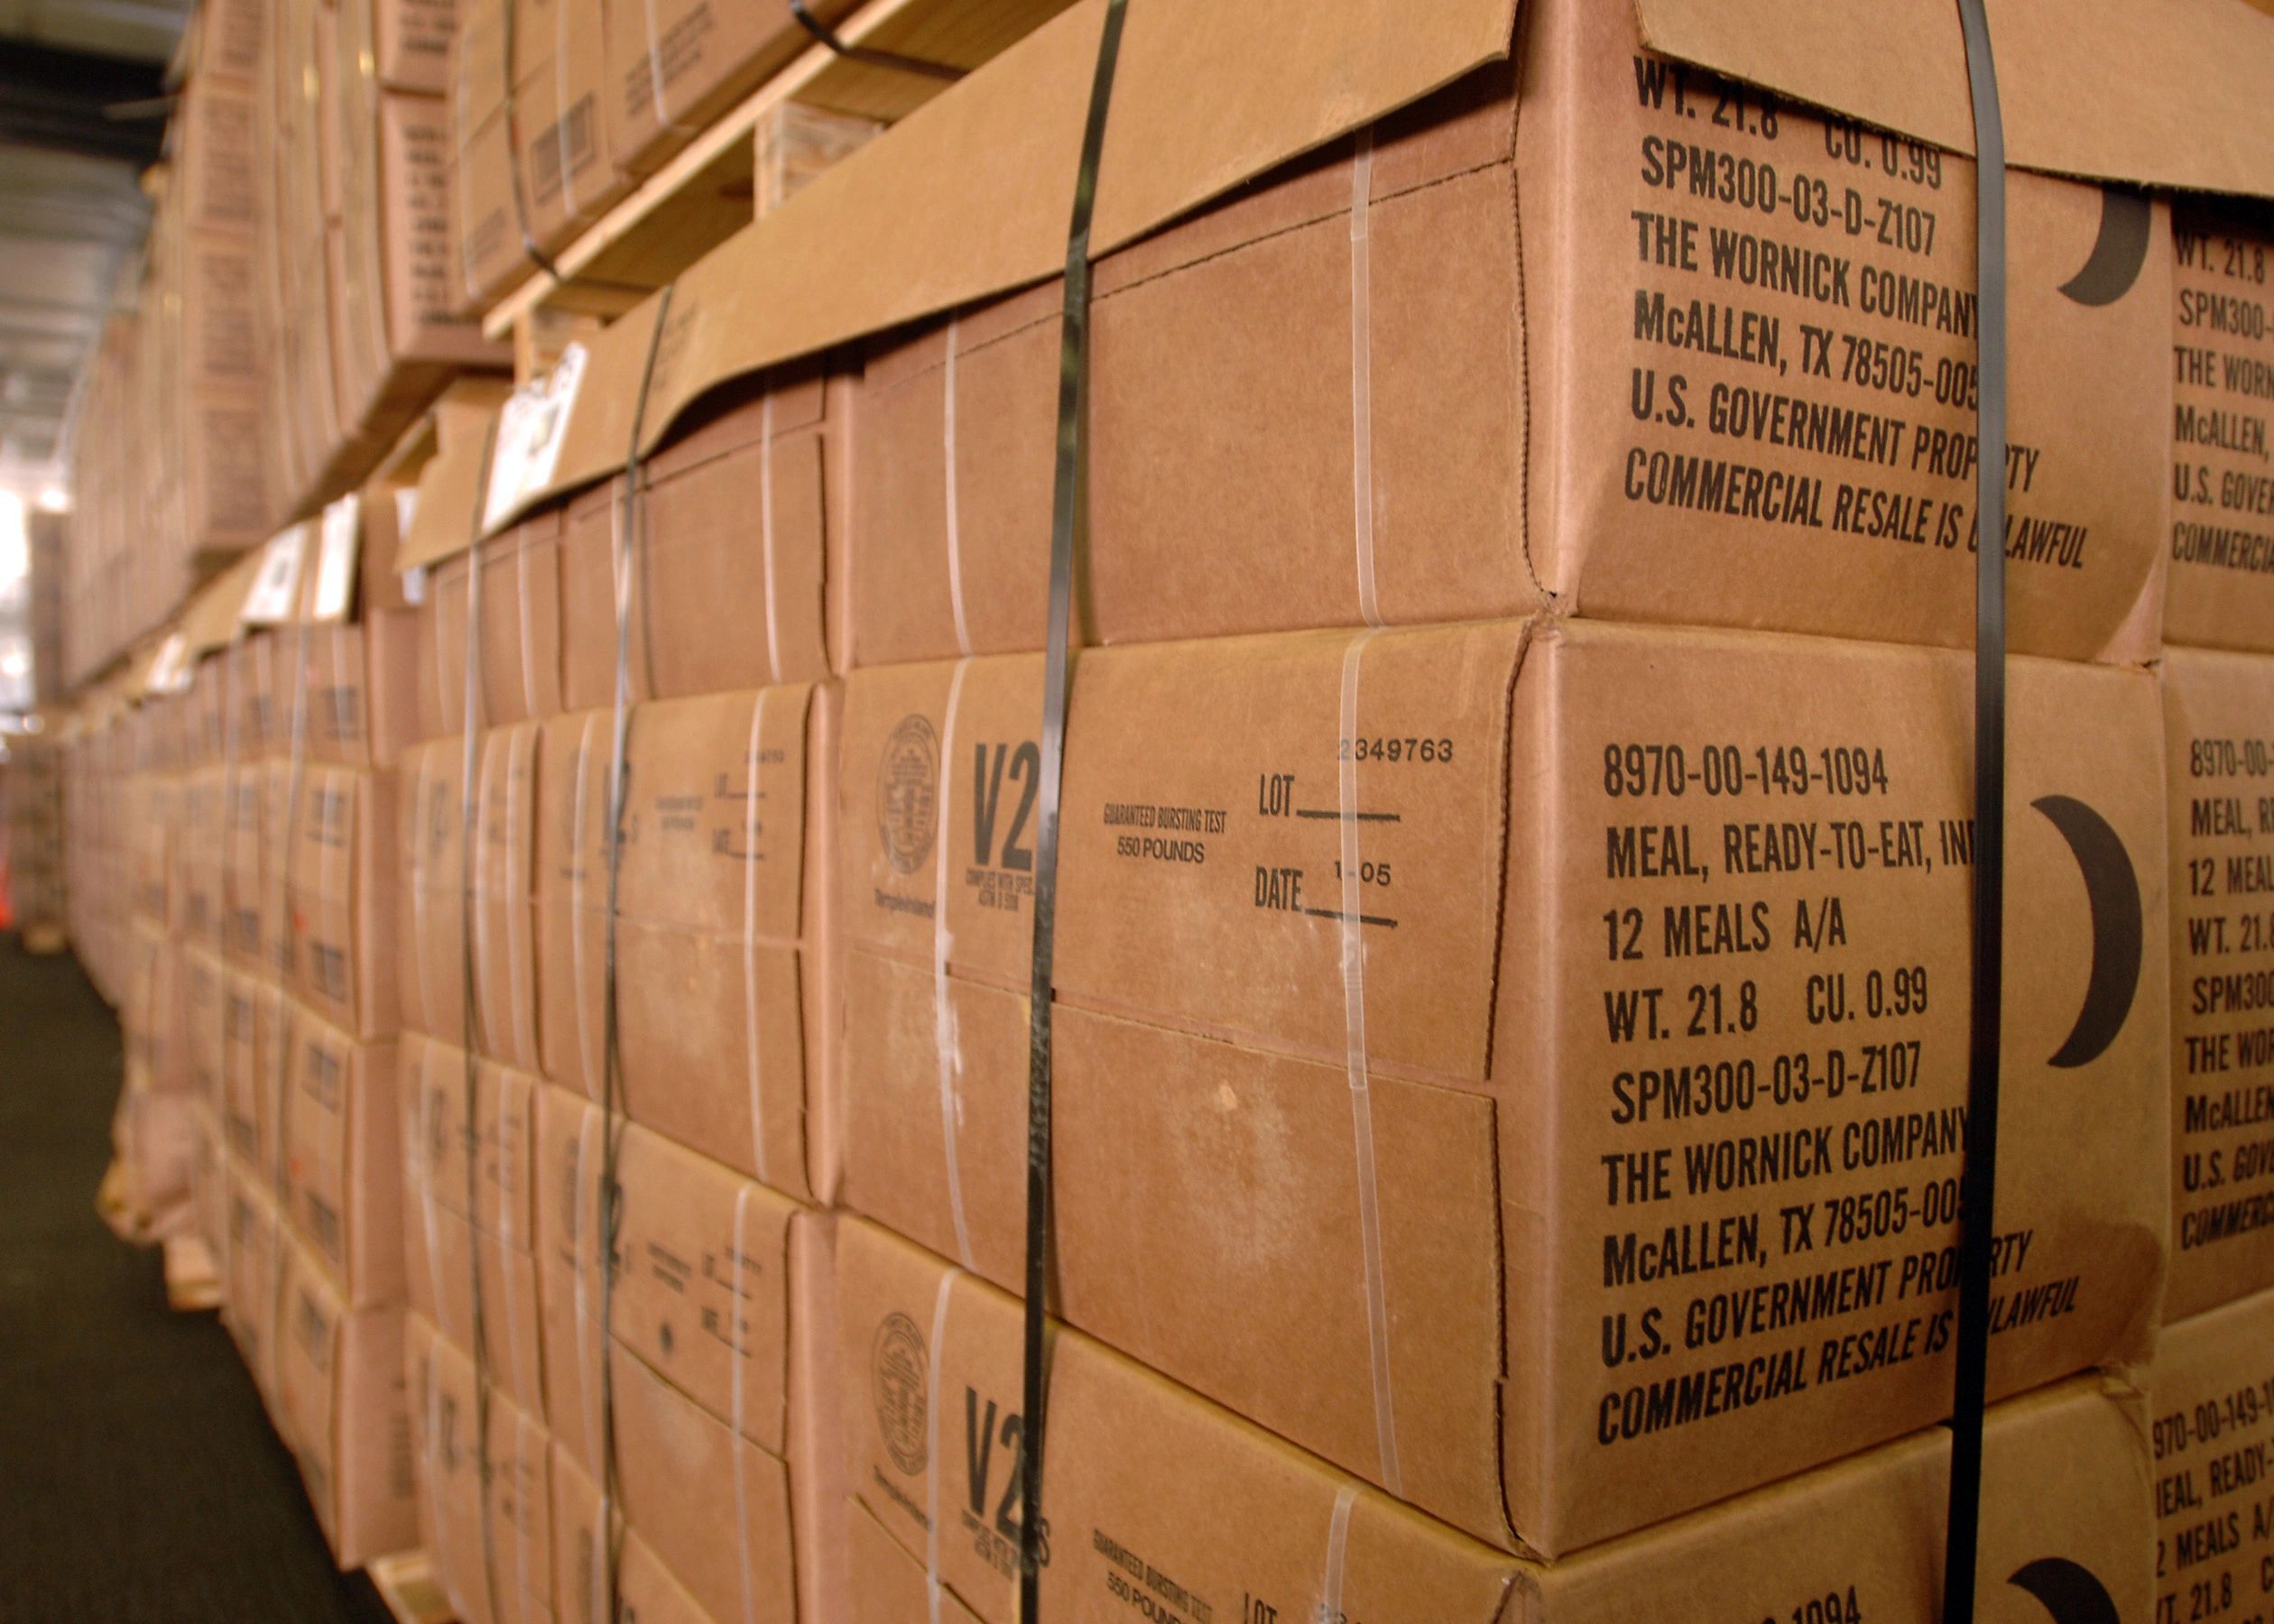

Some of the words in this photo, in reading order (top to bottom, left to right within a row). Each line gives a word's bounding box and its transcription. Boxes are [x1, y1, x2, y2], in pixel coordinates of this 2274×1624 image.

[1633, 55, 1696, 119] WT.
[1641, 134, 1936, 256] SPM300-03-D-Z107
[1632, 210, 1697, 271] THE
[1710, 226, 1850, 309] WORNICK
[1635, 290, 1788, 377] McALLEN,
[1800, 324, 1832, 379] TX
[2179, 288, 2274, 340] SPM300-
[2174, 345, 2216, 388] THE
[1631, 368, 1694, 429] U.S.
[1709, 383, 1906, 468] GOVERNMENT
[1911, 424, 2039, 493] PROPTY
[2176, 404, 2269, 463] McALLEN,
[1625, 448, 1824, 530] COMMERCIAL
[1833, 484, 1933, 545] RESALE
[1936, 502, 1964, 549] IS
[1967, 508, 2087, 568] LAWFUL
[2175, 462, 2214, 504] U.S.
[1604, 744, 1889, 798] 8970-00-149-1094
[2190, 738, 2274, 778] 8970-00-
[1158, 807, 1202, 832] BURSTING
[1204, 809, 1227, 834] TEST
[1259, 774, 1295, 817] LOT
[2191, 798, 2252, 838] MEAL,
[1117, 835, 1141, 856] 550
[1143, 838, 1206, 863] POUNDS
[1605, 825, 1709, 883] MEAL,
[1724, 819, 1932, 875] READY-TO-EAT,
[2188, 858, 2215, 896] 12
[1255, 865, 1303, 911] DATE
[1603, 909, 1643, 962] 12
[1664, 901, 1770, 957] MEALS
[1794, 898, 1847, 954] A/A
[2188, 917, 2230, 955] WT.
[1604, 988, 1670, 1043] WT.
[1687, 980, 1758, 1036] 21.8
[1806, 973, 1855, 1025] CU.
[1866, 965, 1927, 1019] 0.99
[1611, 1040, 1921, 1125] SPM300-03-D-Z107
[2185, 1035, 2230, 1075] THE
[1602, 1153, 1671, 1206] THE
[1685, 1126, 1833, 1195] WORNICK
[2183, 1150, 2226, 1193] U.S.
[1603, 1207, 1767, 1288] McALLEN,
[1780, 1204, 1814, 1257] TX
[1825, 1176, 1965, 1248] 78505-00
[1602, 1310, 1671, 1368] U.S.
[1686, 1260, 1893, 1352] GOVERNMENT
[1898, 1229, 2034, 1300] PRORTY
[1597, 1354, 1808, 1447] COMMERCIAL
[1818, 1316, 1921, 1390] RESALE
[1924, 1310, 1954, 1356] IS
[1986, 1276, 2080, 1336] LAWFUL
[2153, 1377, 2274, 1460] 970-00-149-1
[2210, 1439, 2274, 1498] READY-
[2176, 1511, 2242, 1571] MEALS
[1132, 1588, 1182, 1624] POUN
[2190, 1572, 2232, 1623] 21.8
